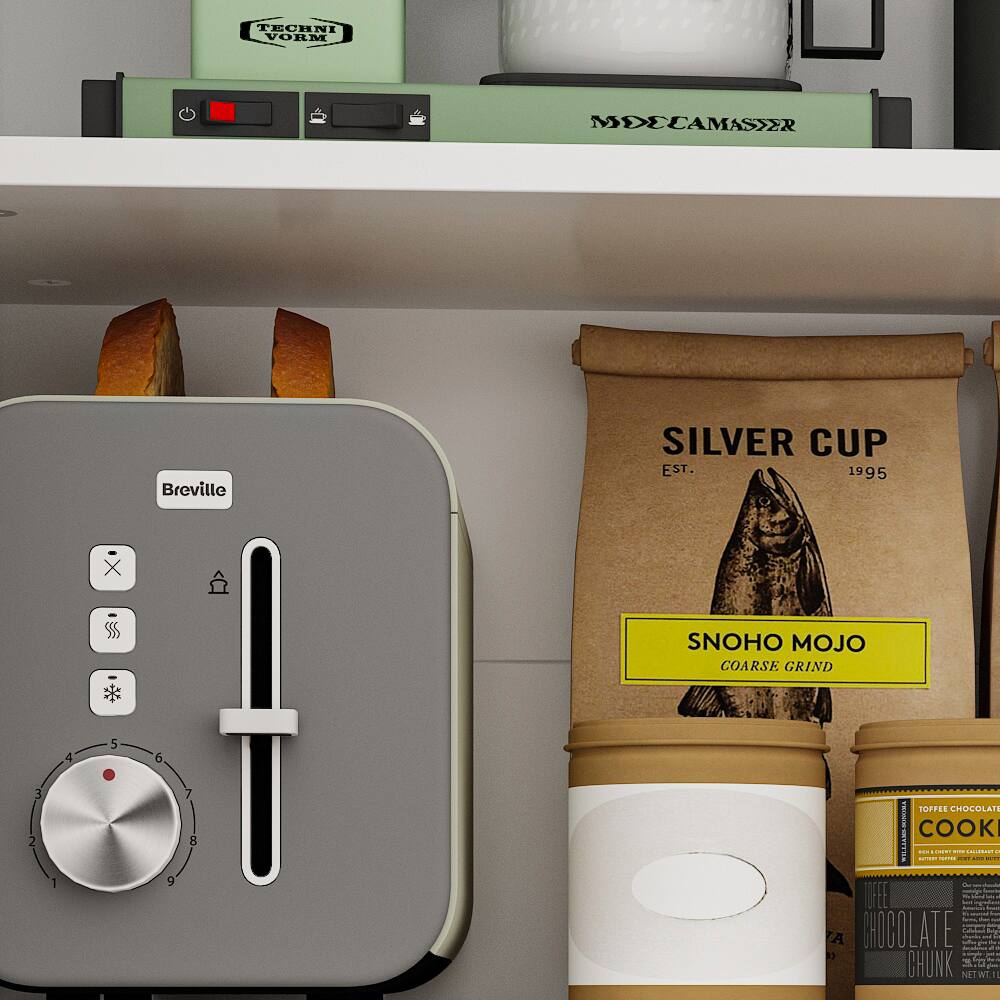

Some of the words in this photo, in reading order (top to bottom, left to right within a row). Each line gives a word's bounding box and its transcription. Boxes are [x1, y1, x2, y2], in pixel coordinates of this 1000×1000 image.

[256, 23, 336, 33] TECHNI
[264, 33, 327, 42] VORM
[661, 426, 794, 458] SILVER
[810, 427, 888, 459] CUP
[661, 464, 695, 478] EST.
[848, 465, 887, 481] 1995
[161, 481, 227, 497] Breville
[686, 631, 785, 655] SNOHO
[791, 632, 867, 656] MOJO
[719, 659, 780, 674] COARSE
[784, 659, 834, 674] GRIND
[110, 739, 118, 750] 5
[65, 753, 73, 763] 4
[155, 752, 163, 763] 6
[34, 789, 42, 799] 3
[185, 789, 193, 799] 7
[919, 805, 948, 813] TOFFEE
[28, 836, 36, 846] 2
[189, 836, 197, 846] 8
[51, 878, 57, 888] 1
[167, 876, 175, 887] 9
[863, 910, 954, 949] CHOCOLATE
[908, 950, 953, 978] CHUNK
[962, 971, 976, 979] NET
